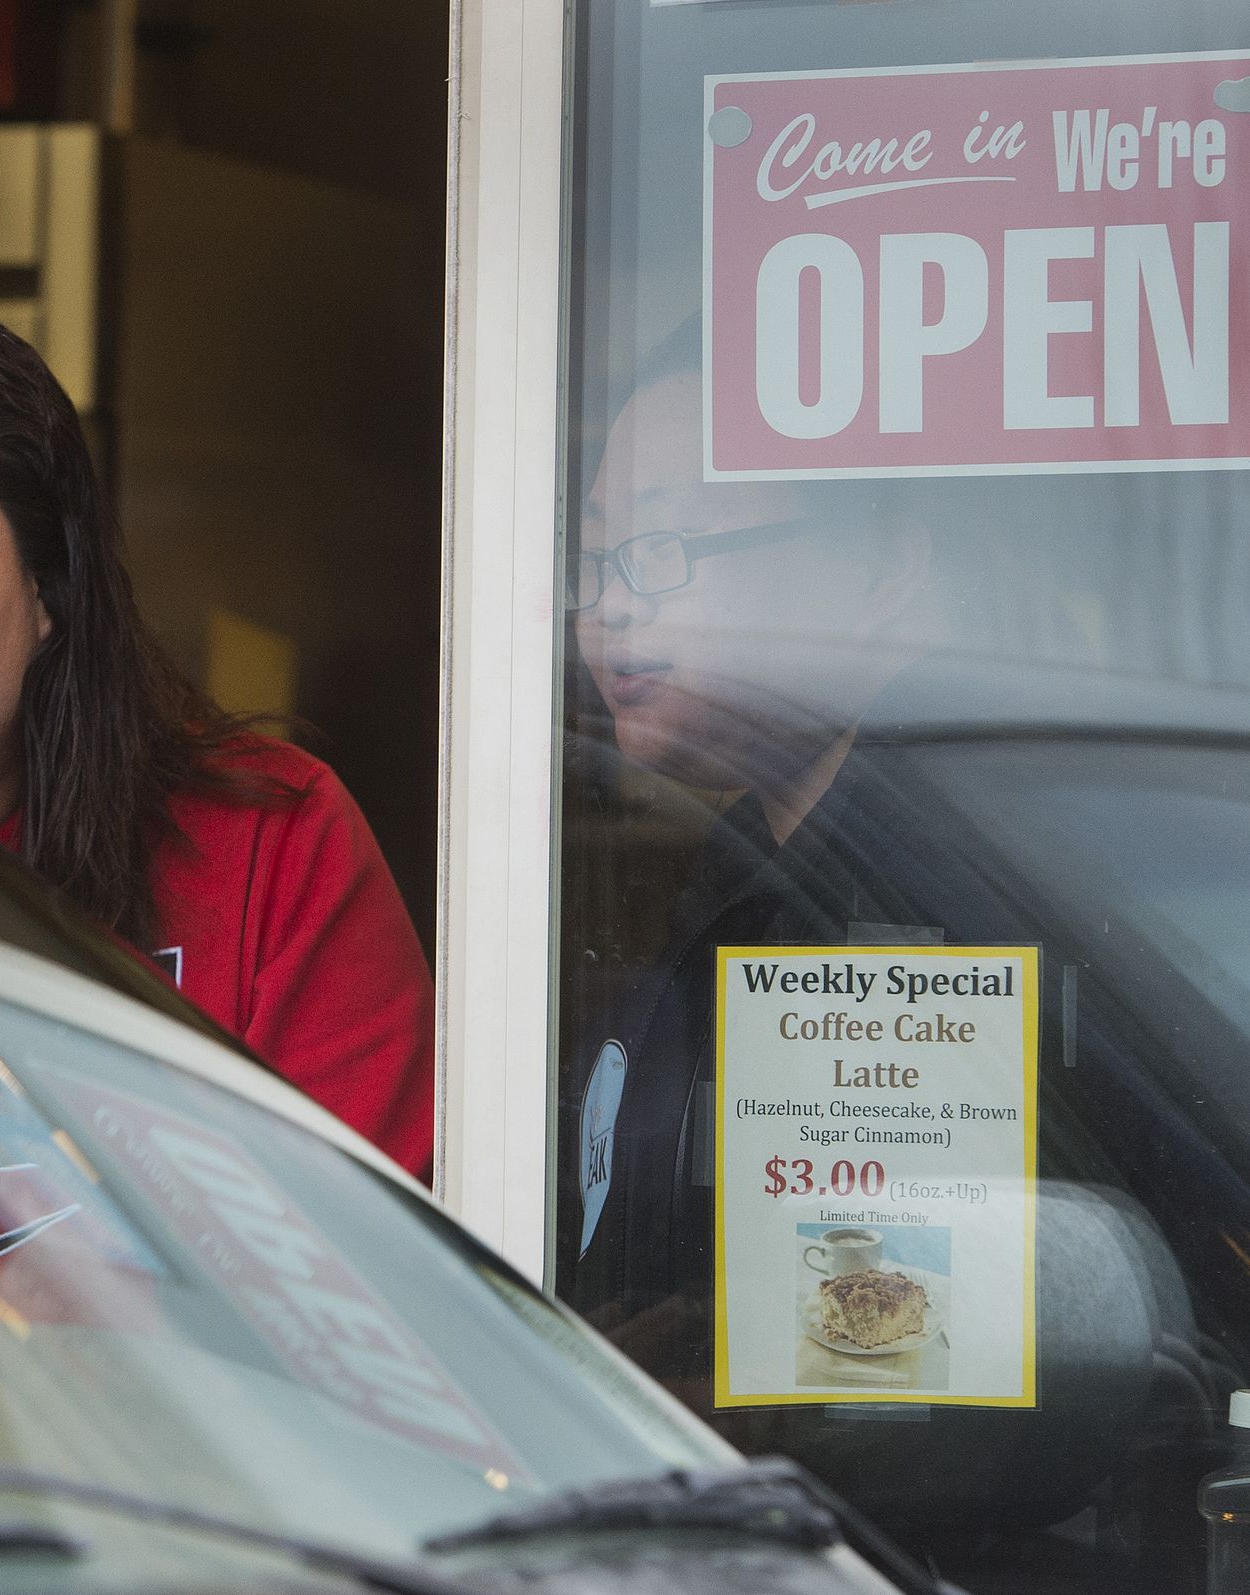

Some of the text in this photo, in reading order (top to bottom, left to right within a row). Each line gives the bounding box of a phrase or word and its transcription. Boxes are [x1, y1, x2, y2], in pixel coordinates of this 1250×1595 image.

[756, 106, 1227, 202] Come in We're
[755, 221, 1231, 441] OPEN
[742, 963, 1015, 1004] Weekly Special
[779, 1011, 976, 1043] Coffee Cake
[833, 1060, 920, 1089] Latte
[736, 1098, 1018, 1121] (Hazelnut, Cheesecake, & Brown
[799, 1125, 952, 1149] Sugar Cinnamon)
[763, 1154, 988, 1205] $3.00 (16oz.+Up)
[819, 1209, 929, 1227] Limited Time Only
